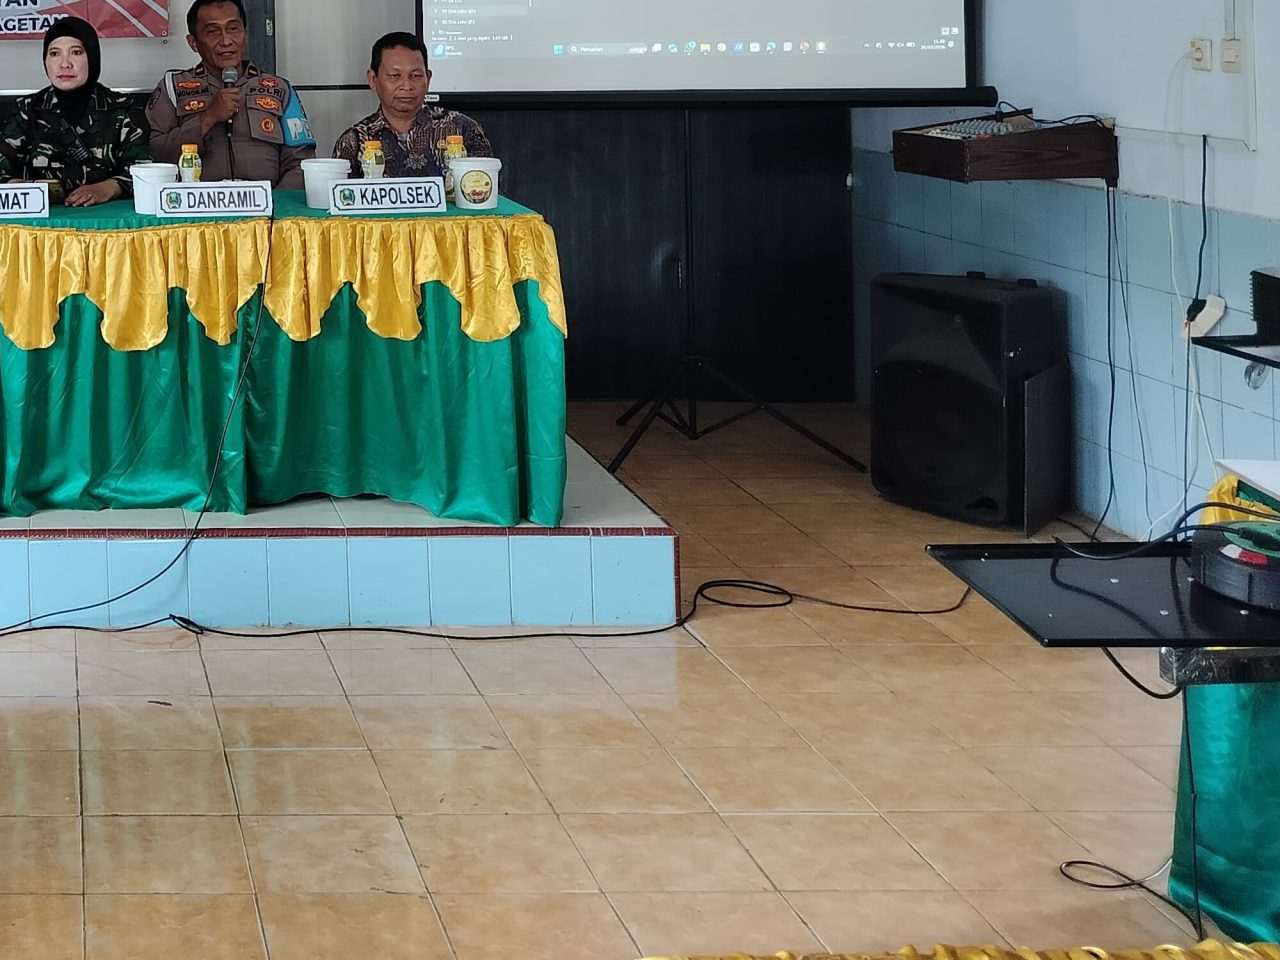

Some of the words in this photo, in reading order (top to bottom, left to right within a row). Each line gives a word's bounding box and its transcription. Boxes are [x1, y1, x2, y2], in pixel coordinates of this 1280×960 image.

[249, 86, 284, 99] POLRI
[187, 190, 261, 209] DANRAMIL
[360, 186, 435, 206] KAPOLSEK
